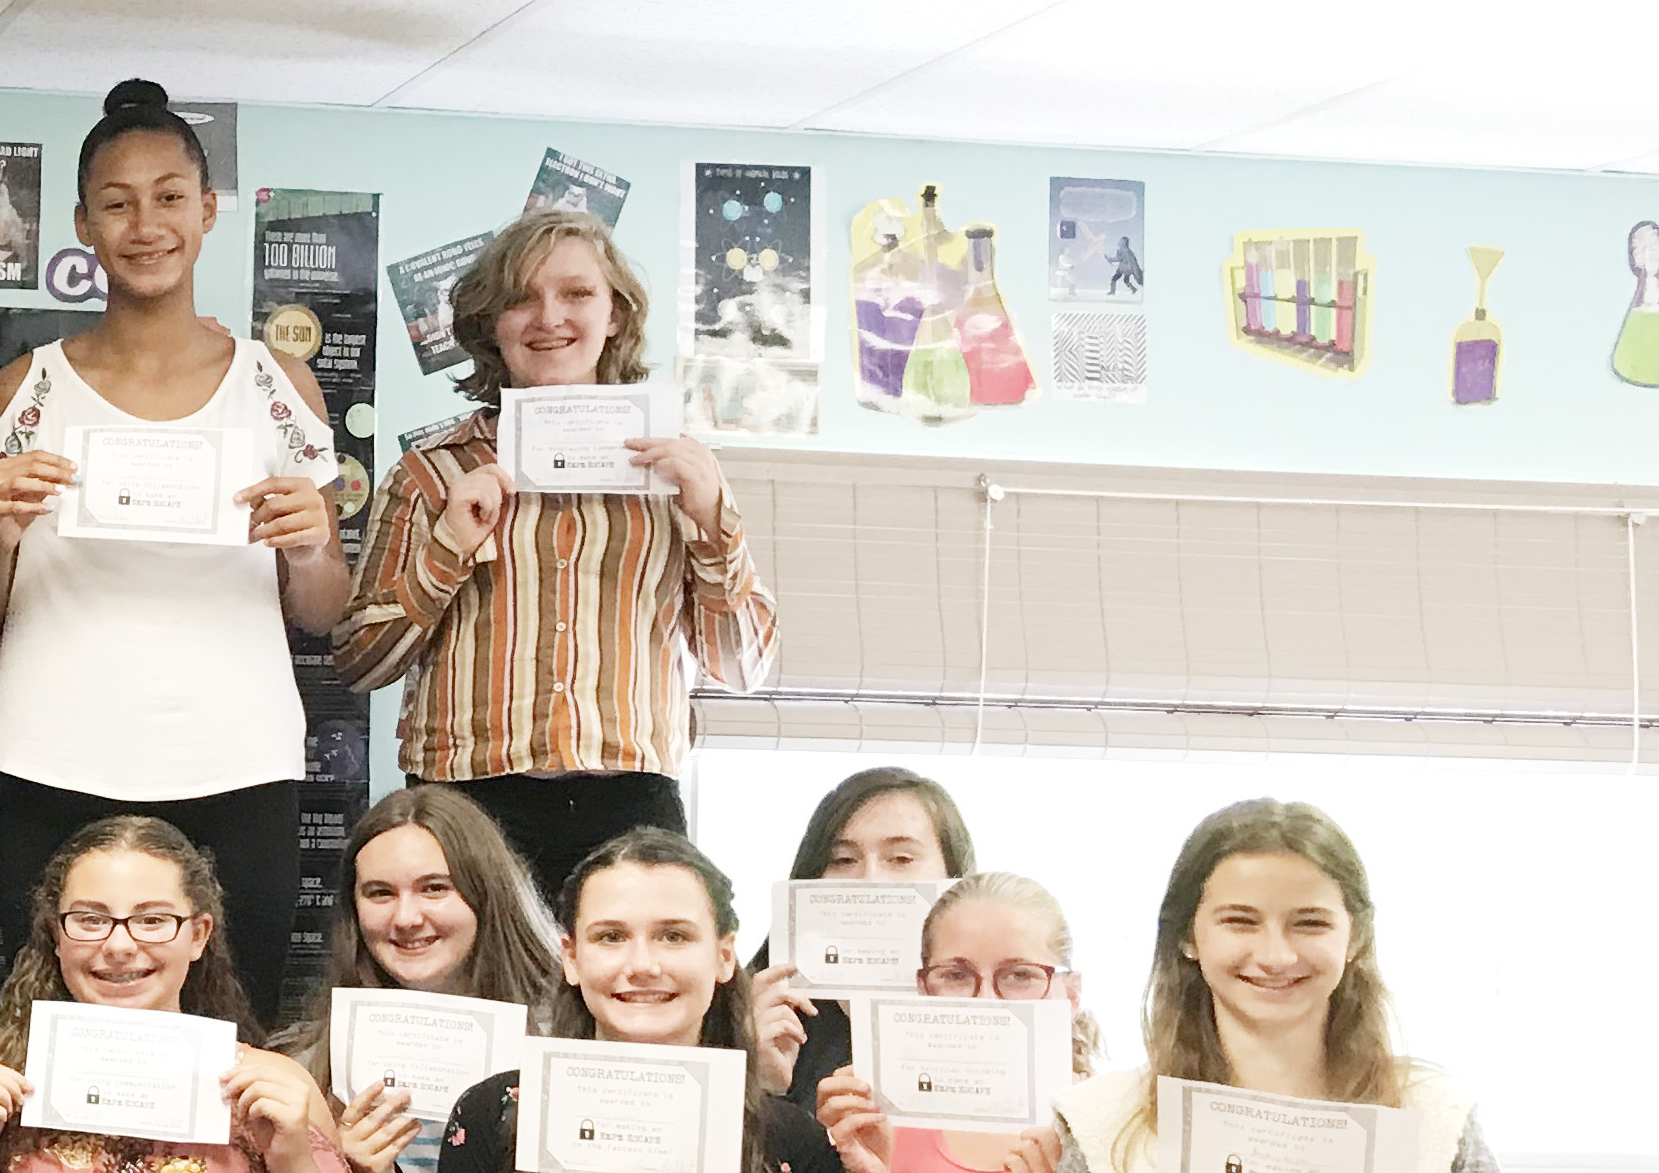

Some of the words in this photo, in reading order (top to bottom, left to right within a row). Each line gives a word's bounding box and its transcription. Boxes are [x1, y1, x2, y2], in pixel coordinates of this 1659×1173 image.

[14, 146, 39, 158] LIGHT
[263, 242, 288, 267] 100
[292, 244, 336, 268] BILLION
[275, 324, 291, 342] THE
[292, 325, 312, 342] SUN
[368, 1012, 474, 1033] CONGRATULATIONS!
[566, 1065, 686, 1085] CONGRATULATIONS!
[1209, 1100, 1349, 1130] CONGRATULATIONS!
